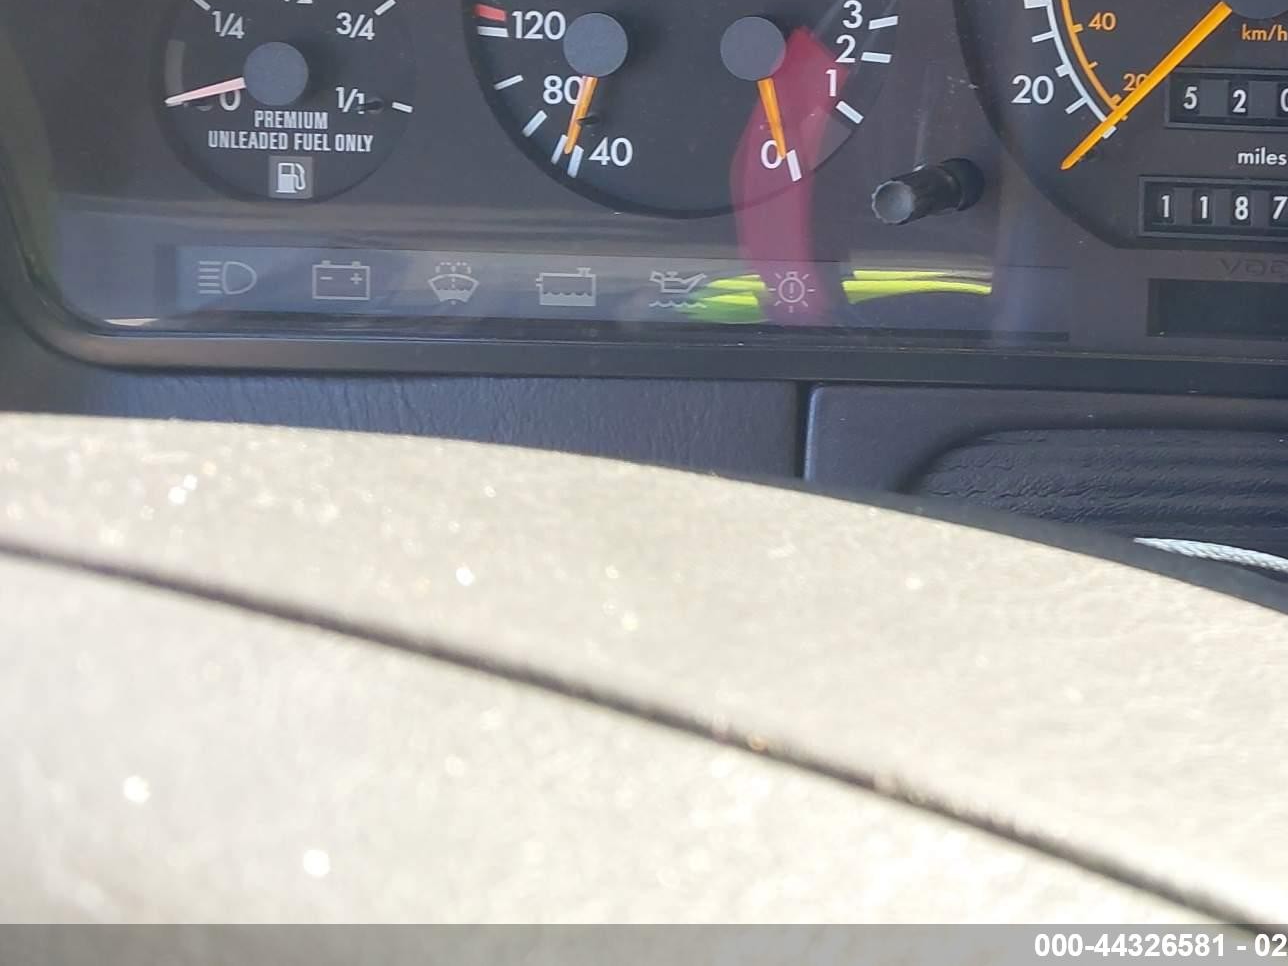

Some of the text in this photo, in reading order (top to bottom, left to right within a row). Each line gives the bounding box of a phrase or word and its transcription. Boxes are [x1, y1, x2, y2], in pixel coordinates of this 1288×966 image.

[212, 10, 245, 39] 1/4
[336, 12, 375, 40] 3/4
[511, 10, 566, 41] 120
[843, 0, 862, 29] 3
[1088, 12, 1117, 31] 40
[1241, 24, 1288, 42] km/h
[835, 35, 855, 63] 2
[543, 75, 583, 105] 80
[825, 68, 837, 97] 1
[1011, 75, 1054, 105] 20
[254, 110, 328, 130] PREMIUM
[208, 130, 374, 152] UNLEADED FUEL ONLY
[588, 137, 633, 166] 40
[760, 140, 783, 170] 0
[1237, 147, 1287, 166] miles
